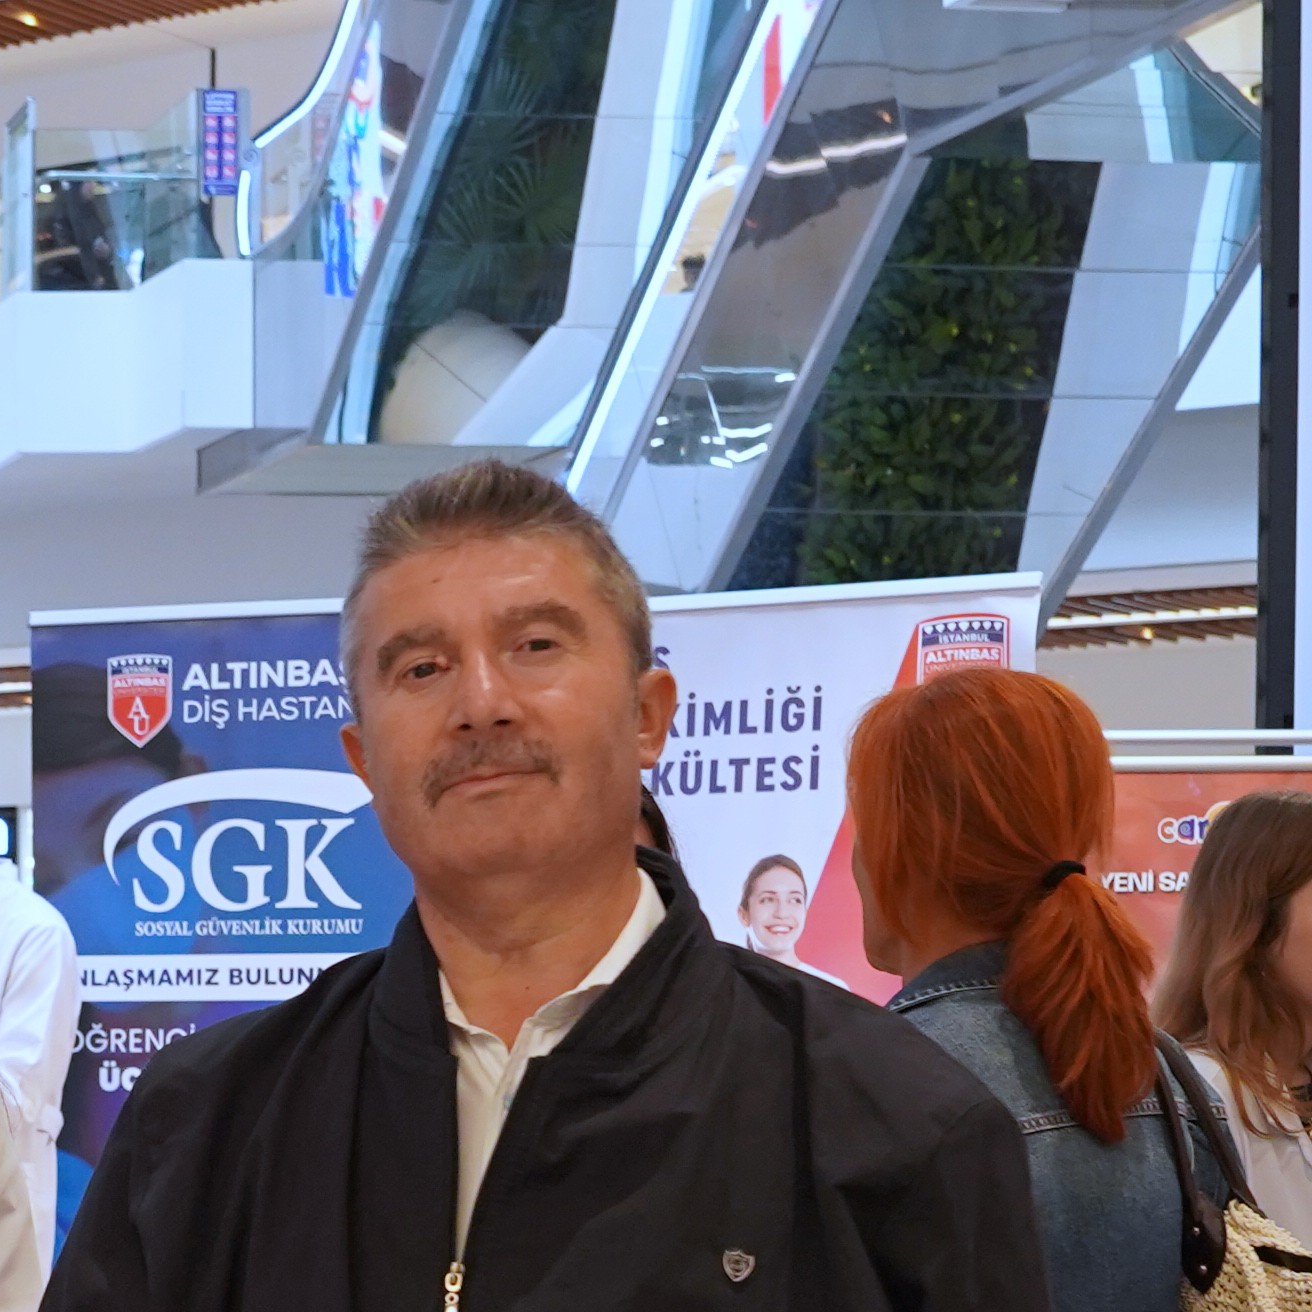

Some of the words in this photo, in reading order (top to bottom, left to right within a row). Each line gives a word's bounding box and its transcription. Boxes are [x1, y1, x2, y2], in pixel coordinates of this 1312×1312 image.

[183, 694, 230, 730] DİŞ
[132, 817, 363, 913] SGK
[135, 920, 194, 937] SOSYAL
[195, 916, 283, 937] GÜVENLİK
[287, 917, 364, 935] KURUMU
[229, 966, 334, 987] BULUN
